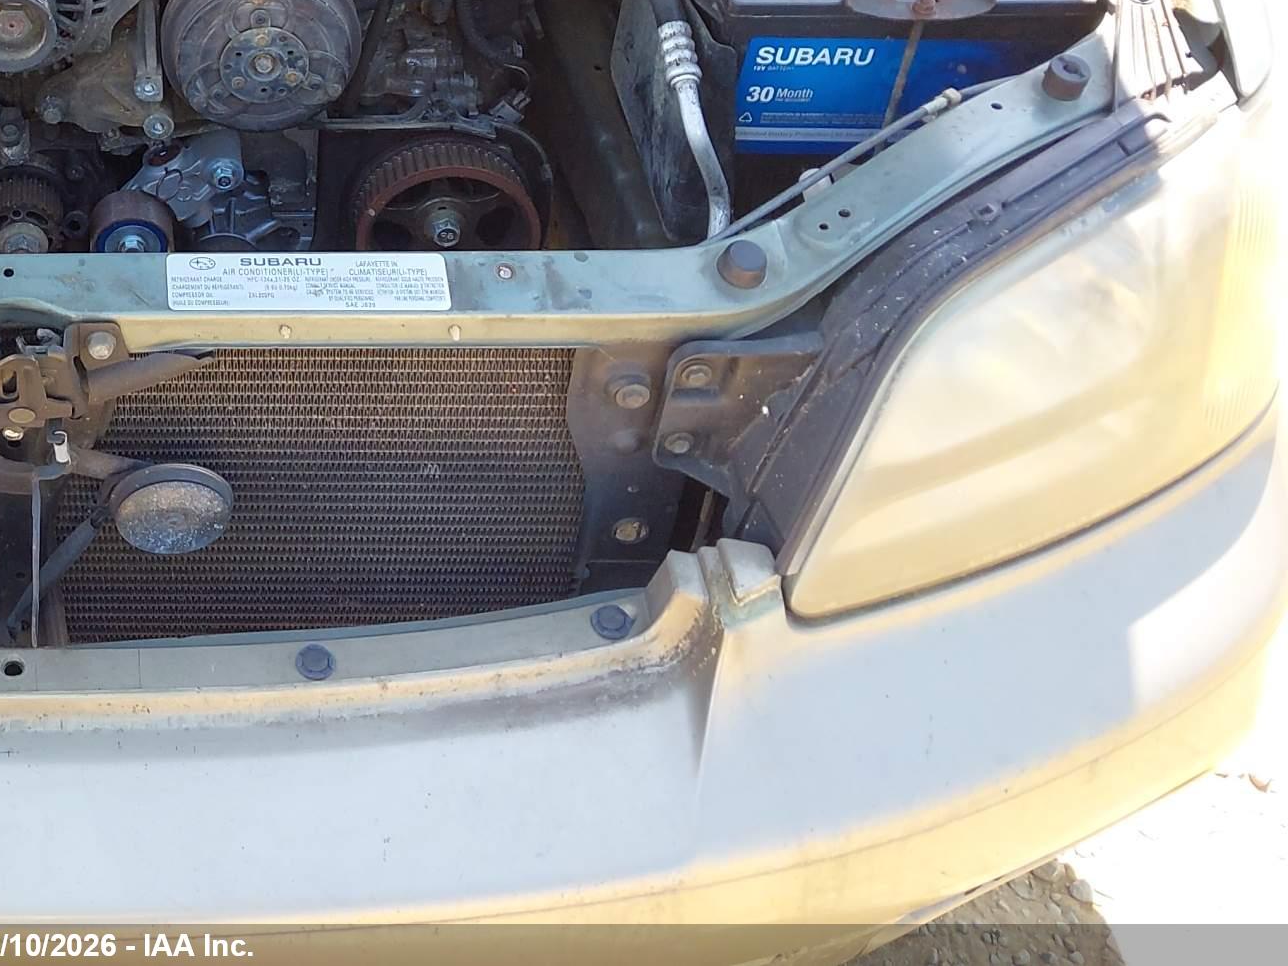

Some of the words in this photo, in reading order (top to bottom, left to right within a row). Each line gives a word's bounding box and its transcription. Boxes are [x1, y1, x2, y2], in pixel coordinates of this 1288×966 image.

[756, 46, 875, 67] SUBARU
[746, 86, 775, 103] 30
[775, 87, 814, 99] Month
[240, 257, 321, 266] SUBARU
[223, 268, 236, 276] AIR
[238, 268, 328, 277] CONDITIONER(LI-TYPE)
